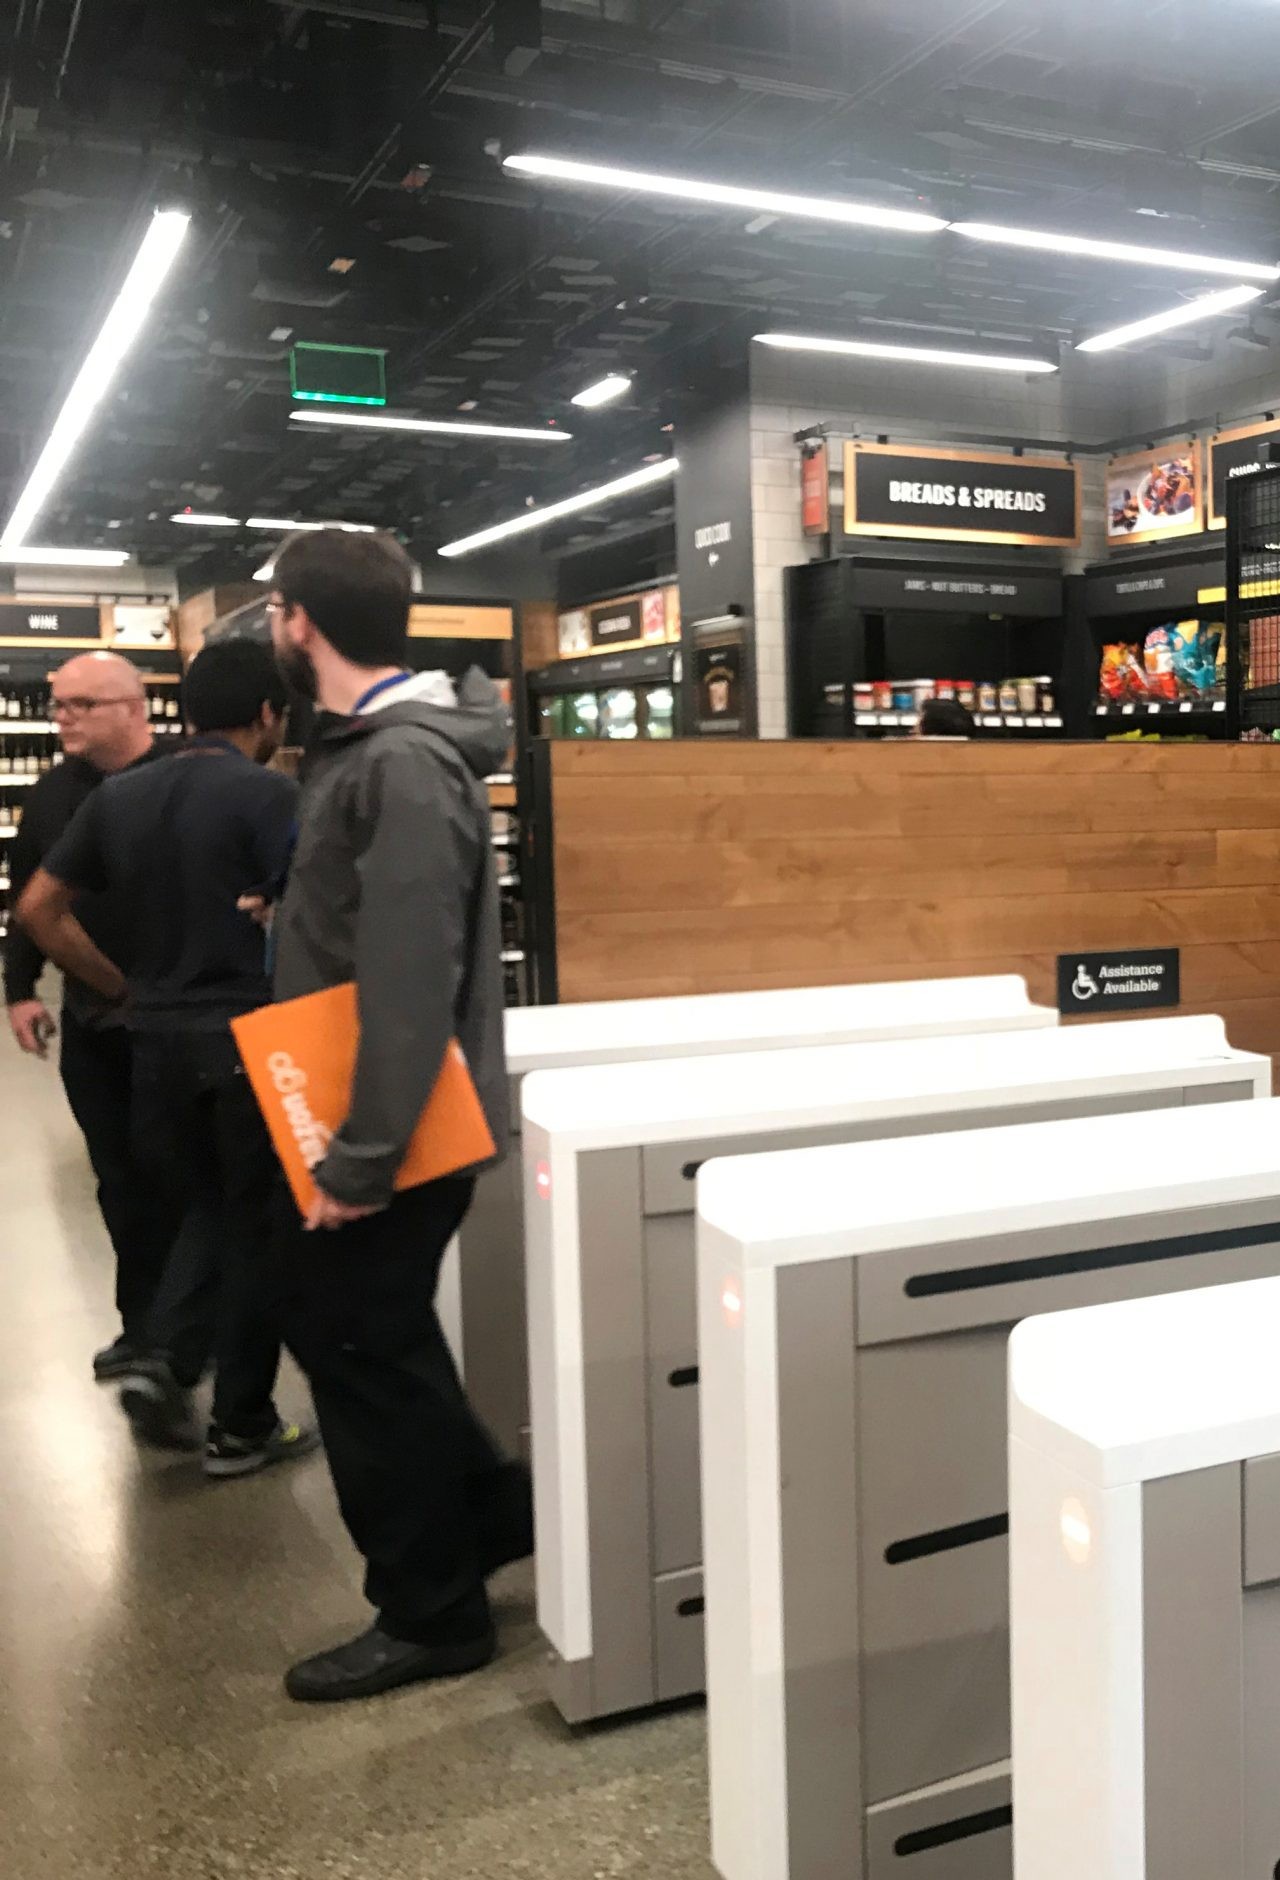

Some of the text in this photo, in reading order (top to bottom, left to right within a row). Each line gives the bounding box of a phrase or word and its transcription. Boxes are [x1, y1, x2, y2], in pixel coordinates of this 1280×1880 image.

[889, 480, 1046, 512] BREADS & SPREADS
[28, 614, 59, 631] WINE
[1099, 964, 1163, 978] Assistance
[1103, 980, 1160, 994] Available
